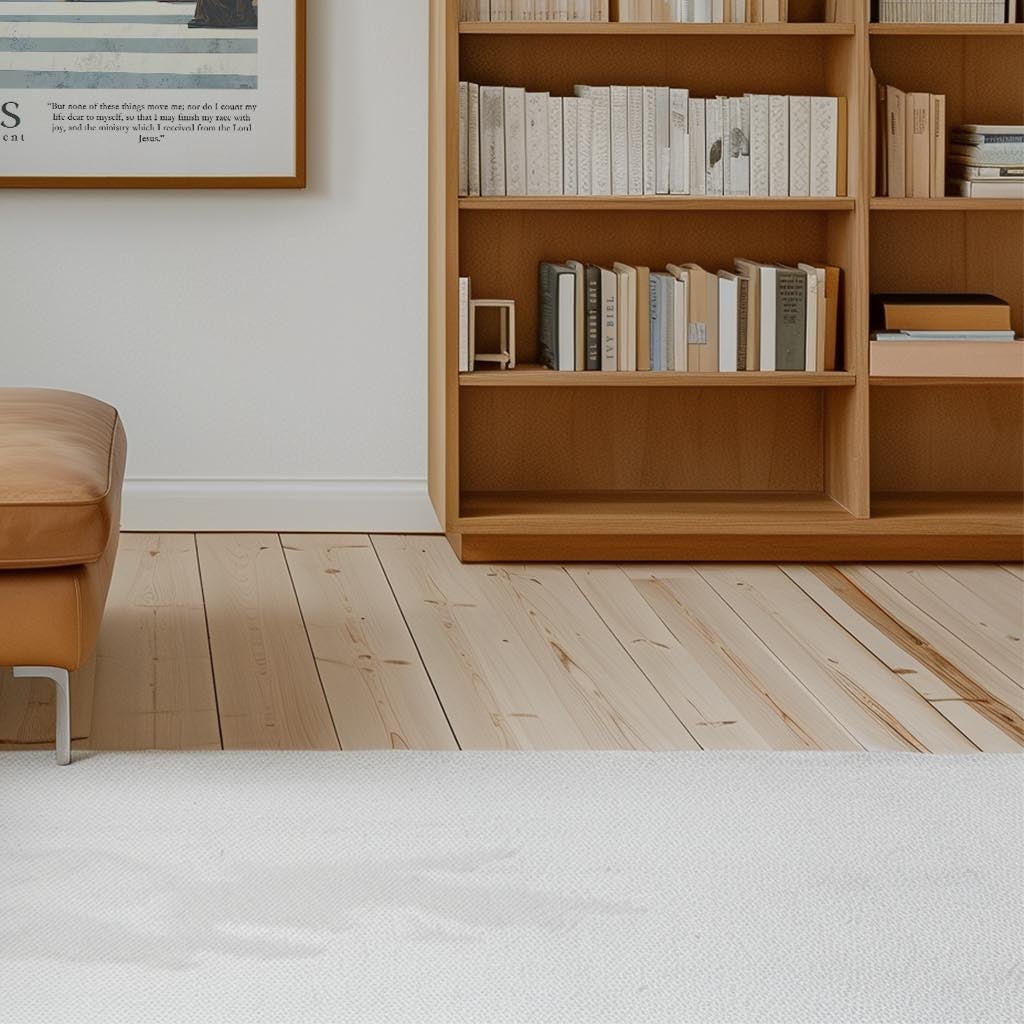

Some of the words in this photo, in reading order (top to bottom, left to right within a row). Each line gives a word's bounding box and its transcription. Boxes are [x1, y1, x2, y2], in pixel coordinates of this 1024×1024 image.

[121, 103, 145, 112] things
[202, 102, 213, 111] do
[245, 104, 257, 112] my
[52, 113, 66, 121] life
[67, 113, 84, 121] dear
[95, 113, 124, 123] myself,
[137, 113, 152, 121] that
[160, 115, 175, 123] may
[178, 112, 200, 121] finish
[202, 115, 214, 123] my
[233, 113, 251, 121] with
[68, 123, 83, 131] and
[84, 123, 96, 131] the
[98, 123, 129, 133] ministry
[132, 123, 154, 131] which
[163, 123, 195, 131] received
[197, 123, 216, 131] from
[218, 123, 231, 131] the
[233, 123, 252, 131] Lord
[606, 296, 614, 327] BIEL
[606, 335, 614, 359] IVY
